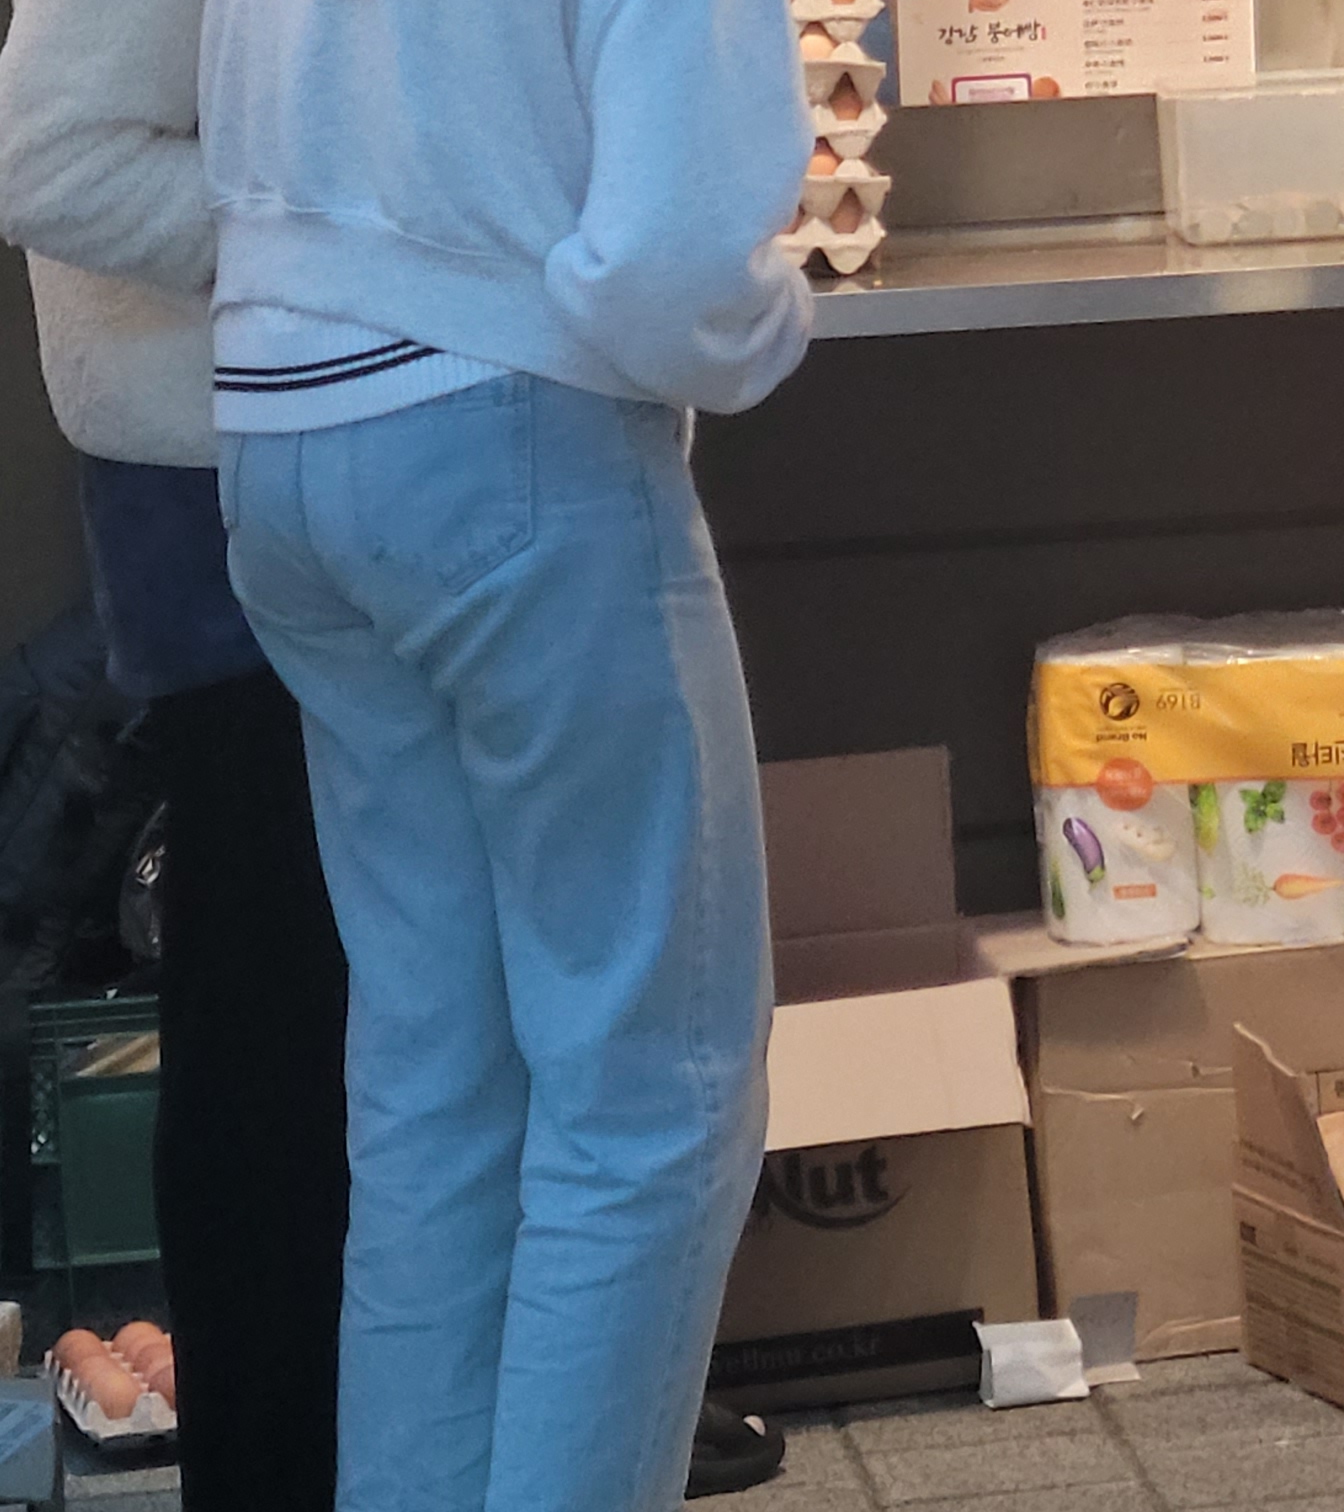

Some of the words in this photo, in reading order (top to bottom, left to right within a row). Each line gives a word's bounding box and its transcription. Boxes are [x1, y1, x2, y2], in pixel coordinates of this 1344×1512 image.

[938, 23, 978, 45] 강남
[988, 18, 1041, 44] 붕어빵
[1155, 693, 1201, 710] B169
[1095, 732, 1130, 743] Brand
[1132, 731, 1147, 741] No
